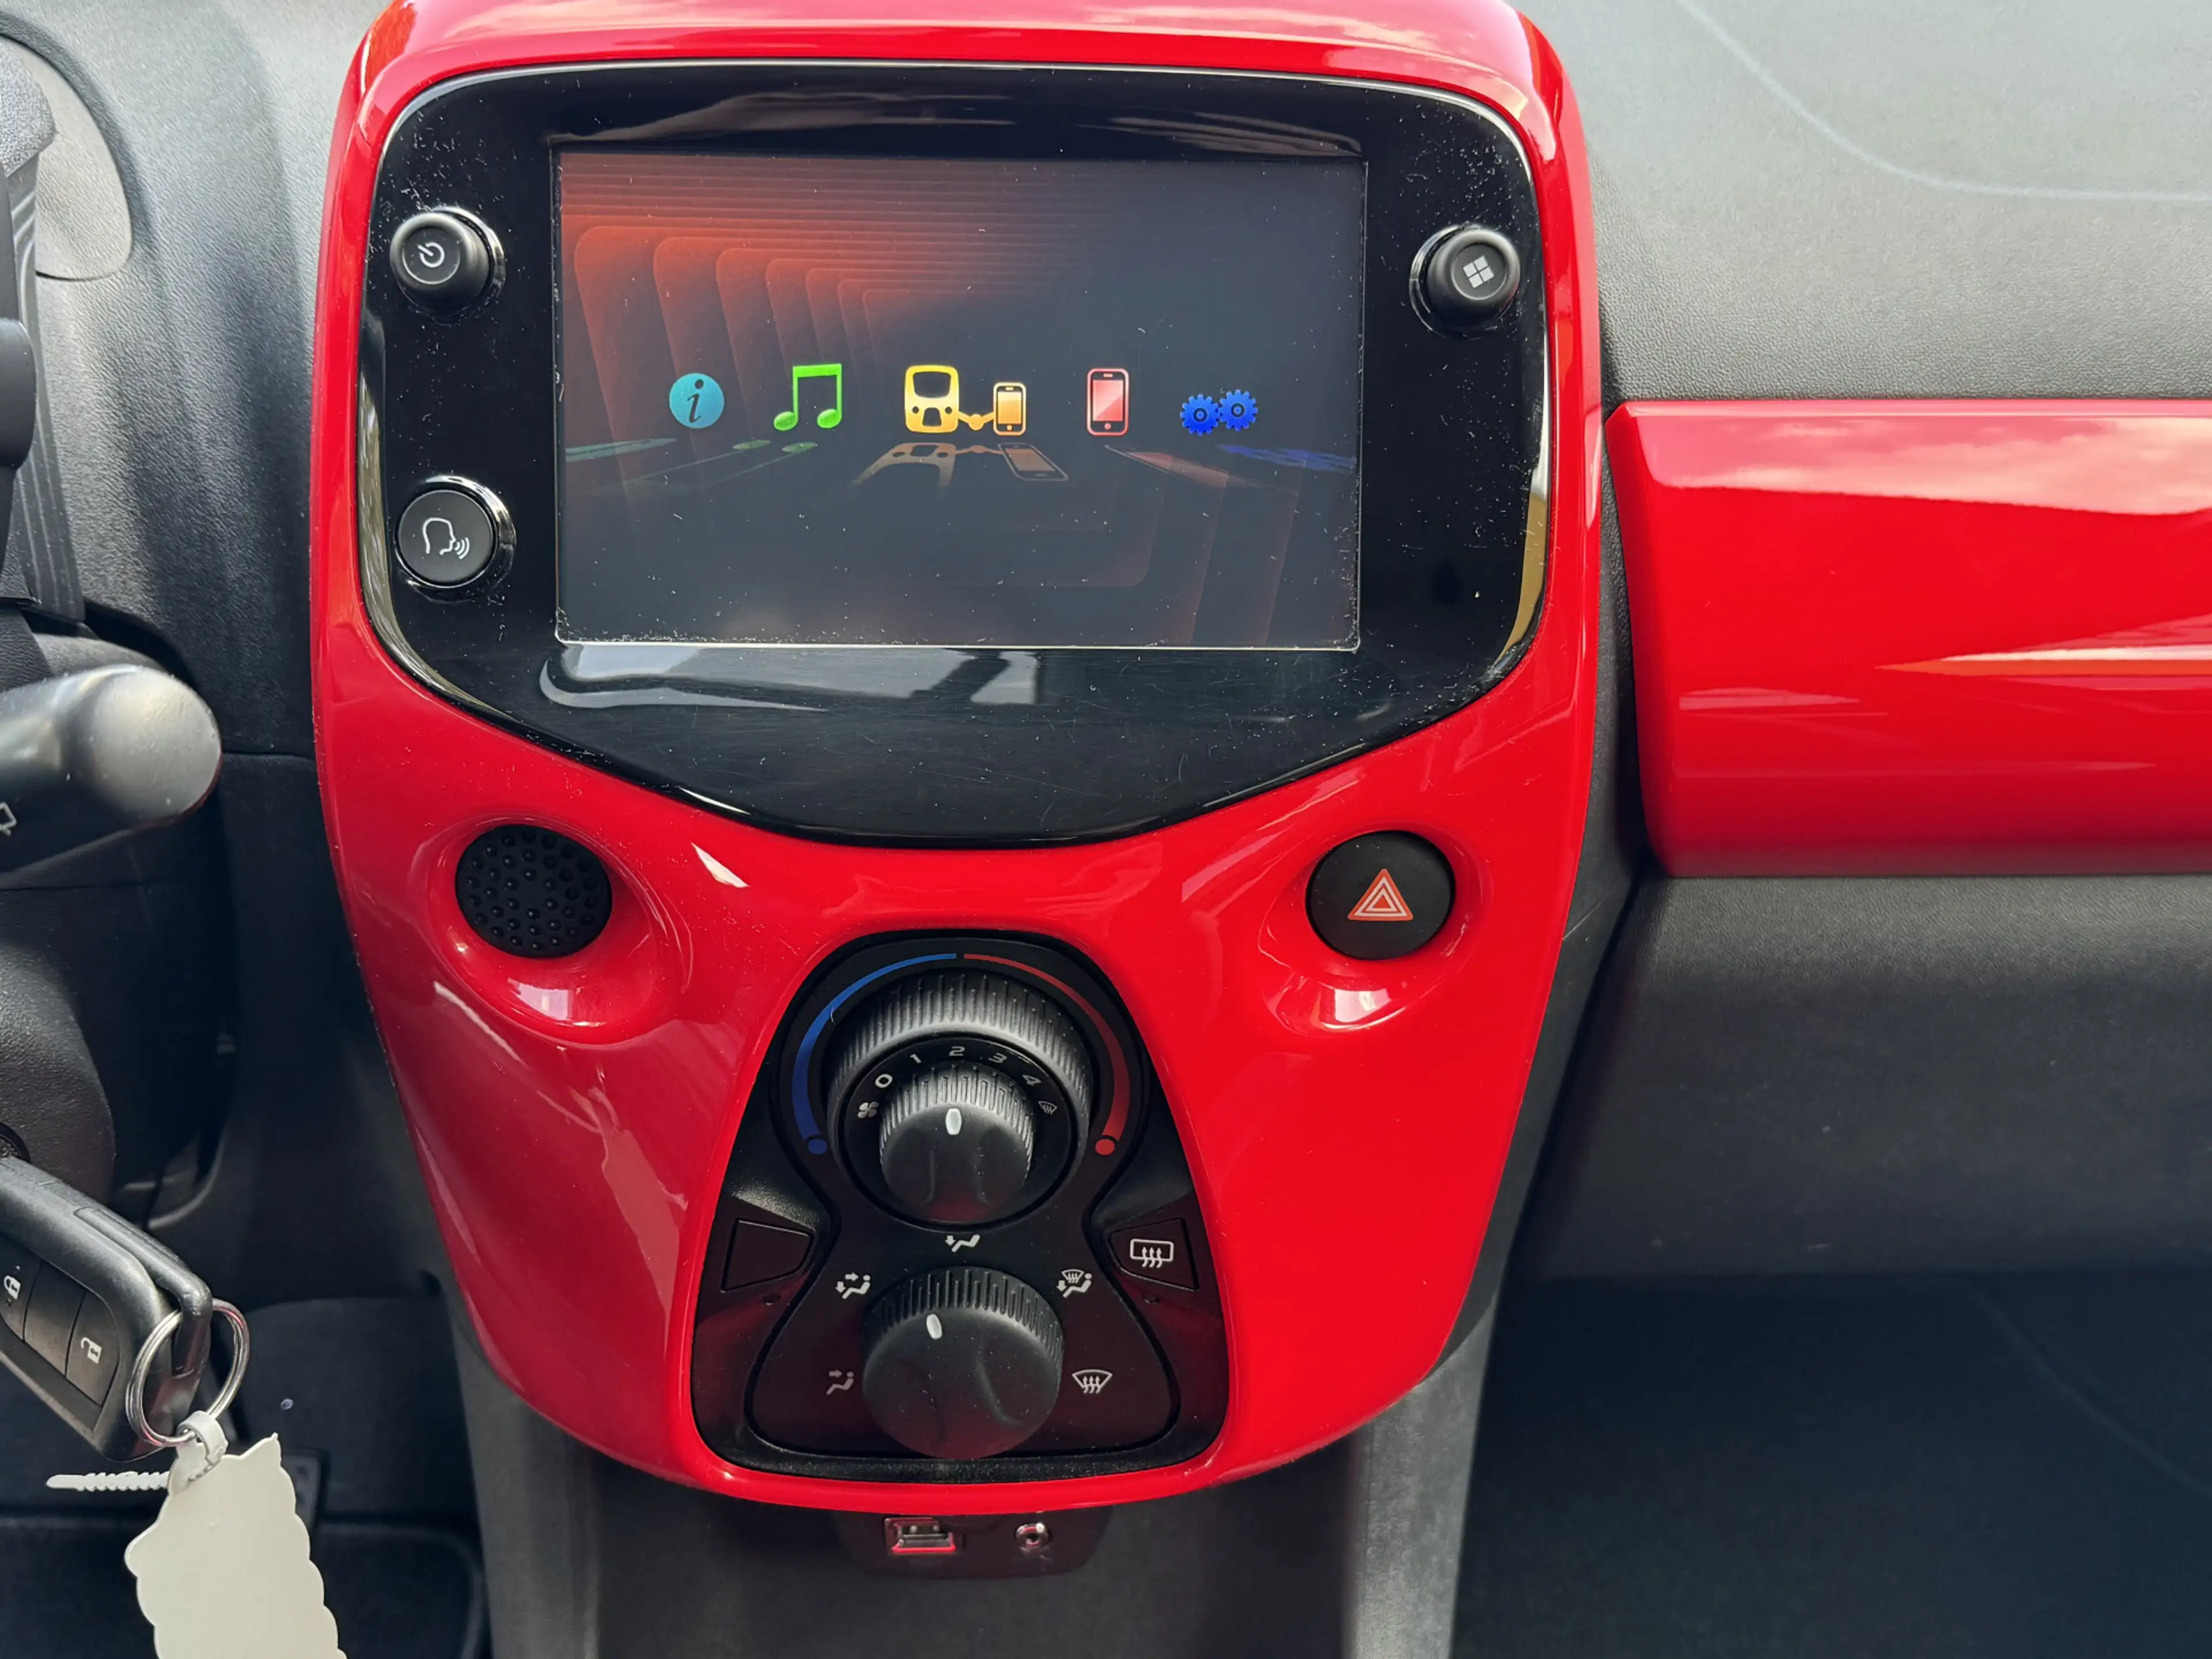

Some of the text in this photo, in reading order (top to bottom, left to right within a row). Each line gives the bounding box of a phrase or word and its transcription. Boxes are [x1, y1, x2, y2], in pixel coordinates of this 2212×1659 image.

[687, 378, 704, 423] i
[910, 1054, 921, 1063] 1
[949, 1046, 965, 1056] 2
[988, 1052, 1007, 1063] 3
[1022, 1074, 1041, 1086] 4
